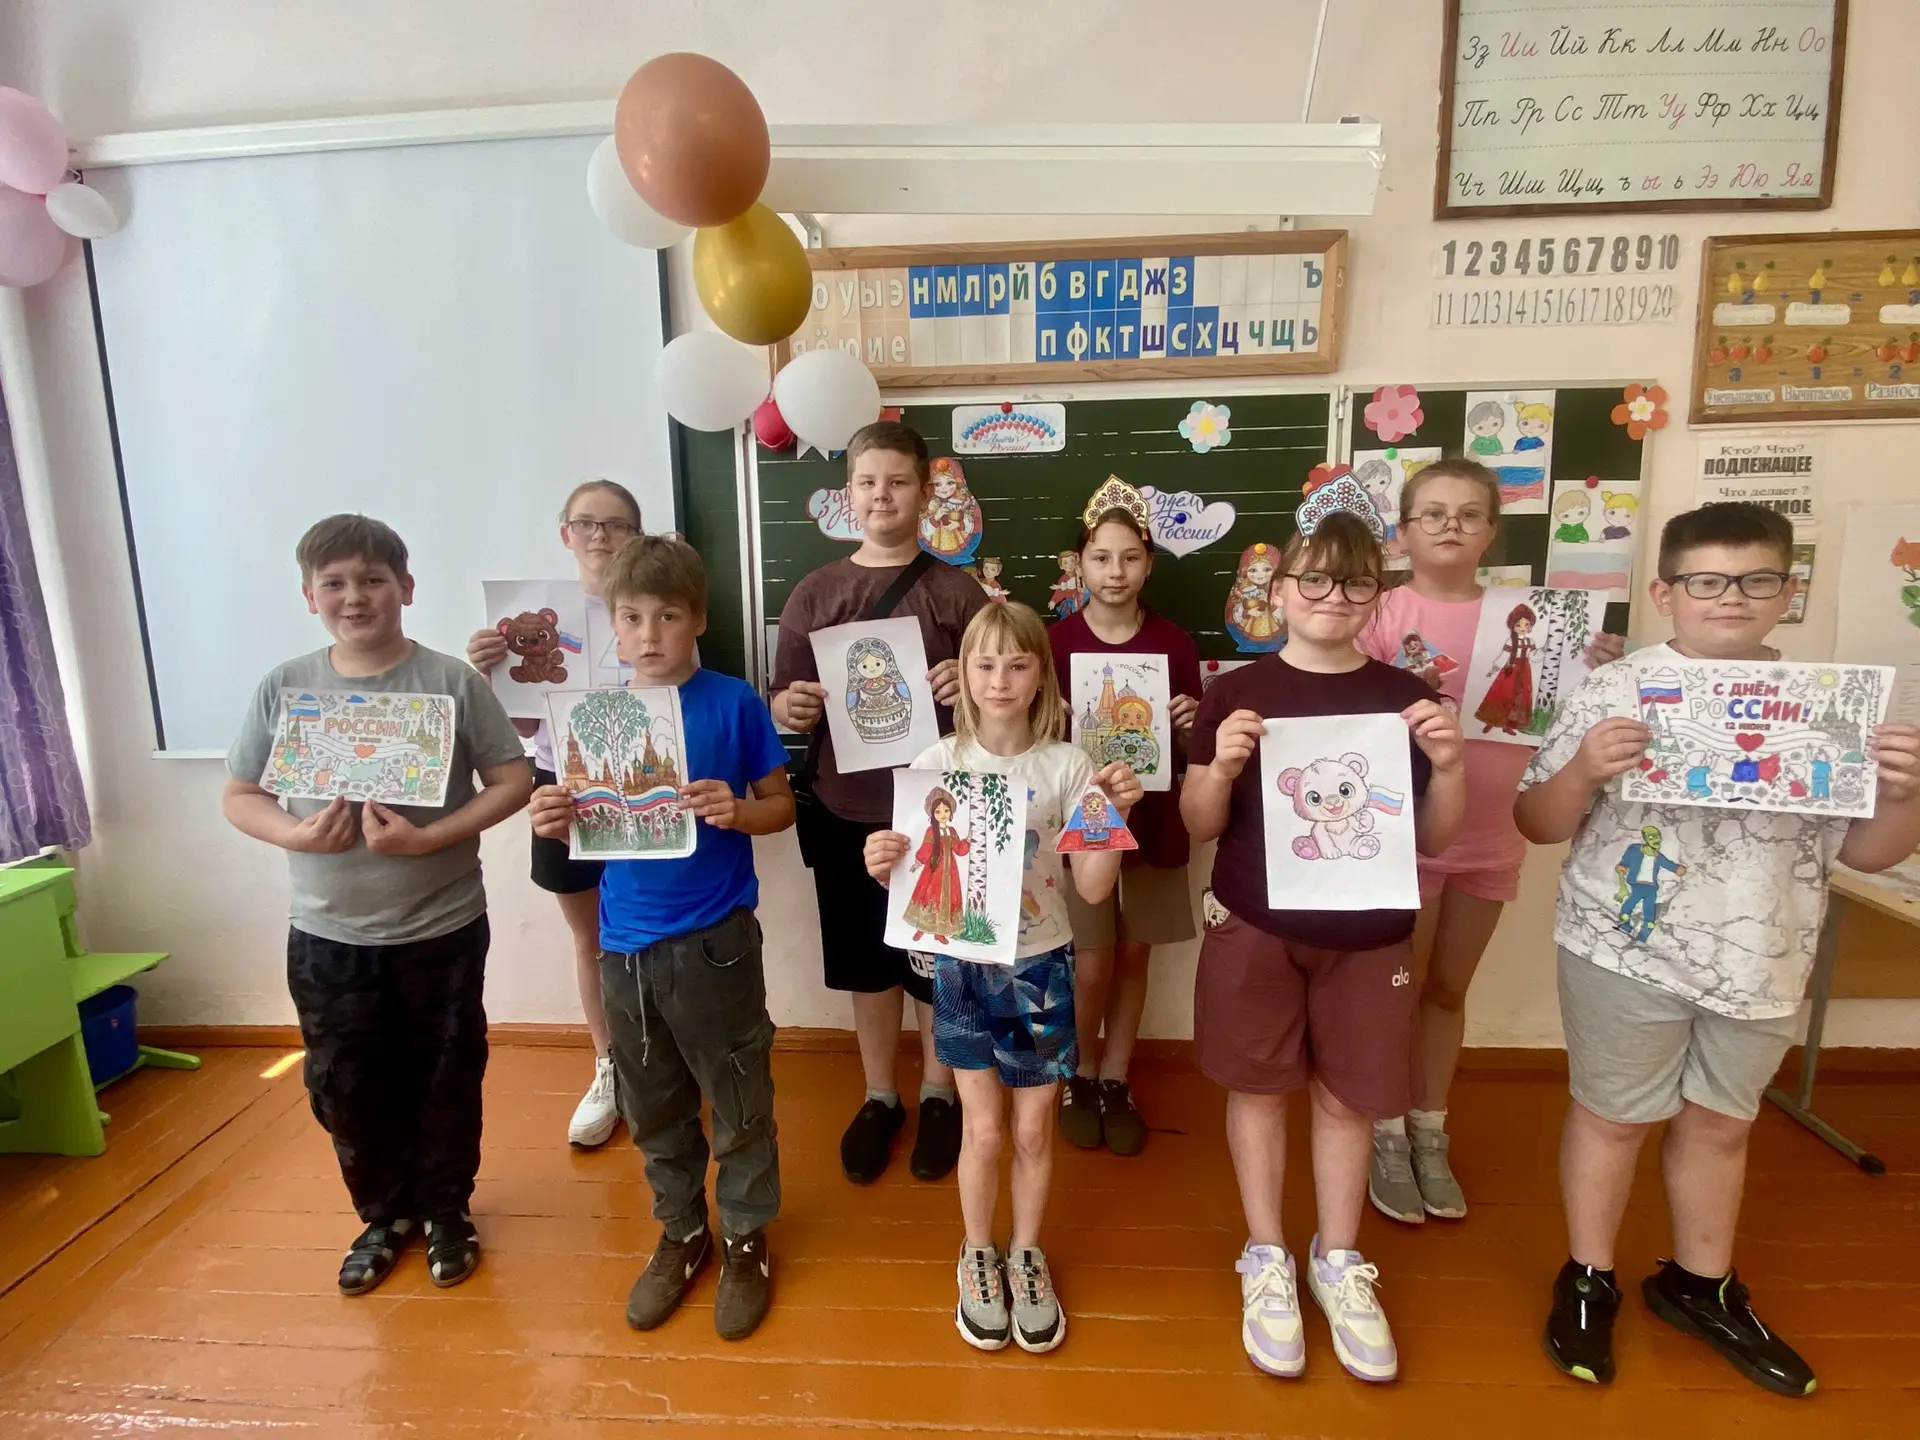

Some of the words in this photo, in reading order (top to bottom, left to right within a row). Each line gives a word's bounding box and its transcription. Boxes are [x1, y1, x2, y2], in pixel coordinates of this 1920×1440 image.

[1462, 35, 1490, 68] Зз
[1500, 31, 1539, 58] Ии
[1549, 25, 1588, 56] Йй
[1598, 27, 1637, 54] Кк
[1646, 27, 1686, 54] Лл
[1693, 27, 1742, 54] Мм
[1751, 27, 1789, 54] Нн
[1798, 26, 1826, 52] Оо
[1458, 99, 1501, 127] Пп
[1511, 97, 1545, 136] Рр
[1554, 95, 1584, 122] Сс
[1592, 93, 1648, 120] Тт
[1658, 92, 1688, 130] Уу
[1694, 92, 1731, 128] Фф
[1739, 93, 1777, 118] Хх
[1785, 94, 1819, 121] Цц
[1454, 172, 1486, 197] Чч
[1498, 169, 1546, 195] Шш
[1557, 168, 1604, 197] Щщ
[1619, 176, 1631, 191] ъ
[1641, 175, 1662, 190] ы
[1673, 175, 1684, 190] ь
[1694, 164, 1719, 189] Ээ
[1729, 163, 1769, 188] Юю
[1780, 162, 1814, 187] Яя
[1442, 240, 1457, 275] 1
[1464, 241, 1483, 277] 2
[1489, 240, 1508, 275] 3
[1514, 238, 1531, 275] 4
[1537, 238, 1555, 275] 5
[1562, 237, 1581, 274] 6
[1586, 236, 1605, 272] 7
[1610, 236, 1630, 273] 8
[1635, 234, 1652, 271] 9
[1657, 234, 1680, 270] 10
[1436, 293, 1454, 325] 11
[1460, 292, 1480, 324] 12
[1481, 290, 1501, 324] 13
[1505, 289, 1527, 324] 14
[1531, 288, 1553, 324] 15
[1556, 287, 1576, 323] 16
[1579, 287, 1600, 322] 17
[1603, 286, 1625, 322] 18
[1628, 285, 1648, 321] 19
[1650, 284, 1673, 318] 20
[1741, 289, 1755, 305] 2
[1810, 288, 1821, 305] 1
[1889, 364, 1903, 379] 2
[1720, 445, 1761, 456] Кто?
[1766, 444, 1805, 454] Что?
[1704, 456, 1812, 476] ПОДЛЕЖАЩЕЕ
[1719, 487, 1747, 498] Что
[1749, 487, 1798, 497] делает
[1157, 515, 1222, 541] России!
[1713, 682, 1724, 696] С
[1728, 680, 1780, 698] ДНЁМ
[1689, 697, 1813, 724] РОССИИ!
[324, 717, 409, 737] РОССИИ!
[1725, 721, 1736, 731] 12
[1391, 965, 1410, 988] alo
